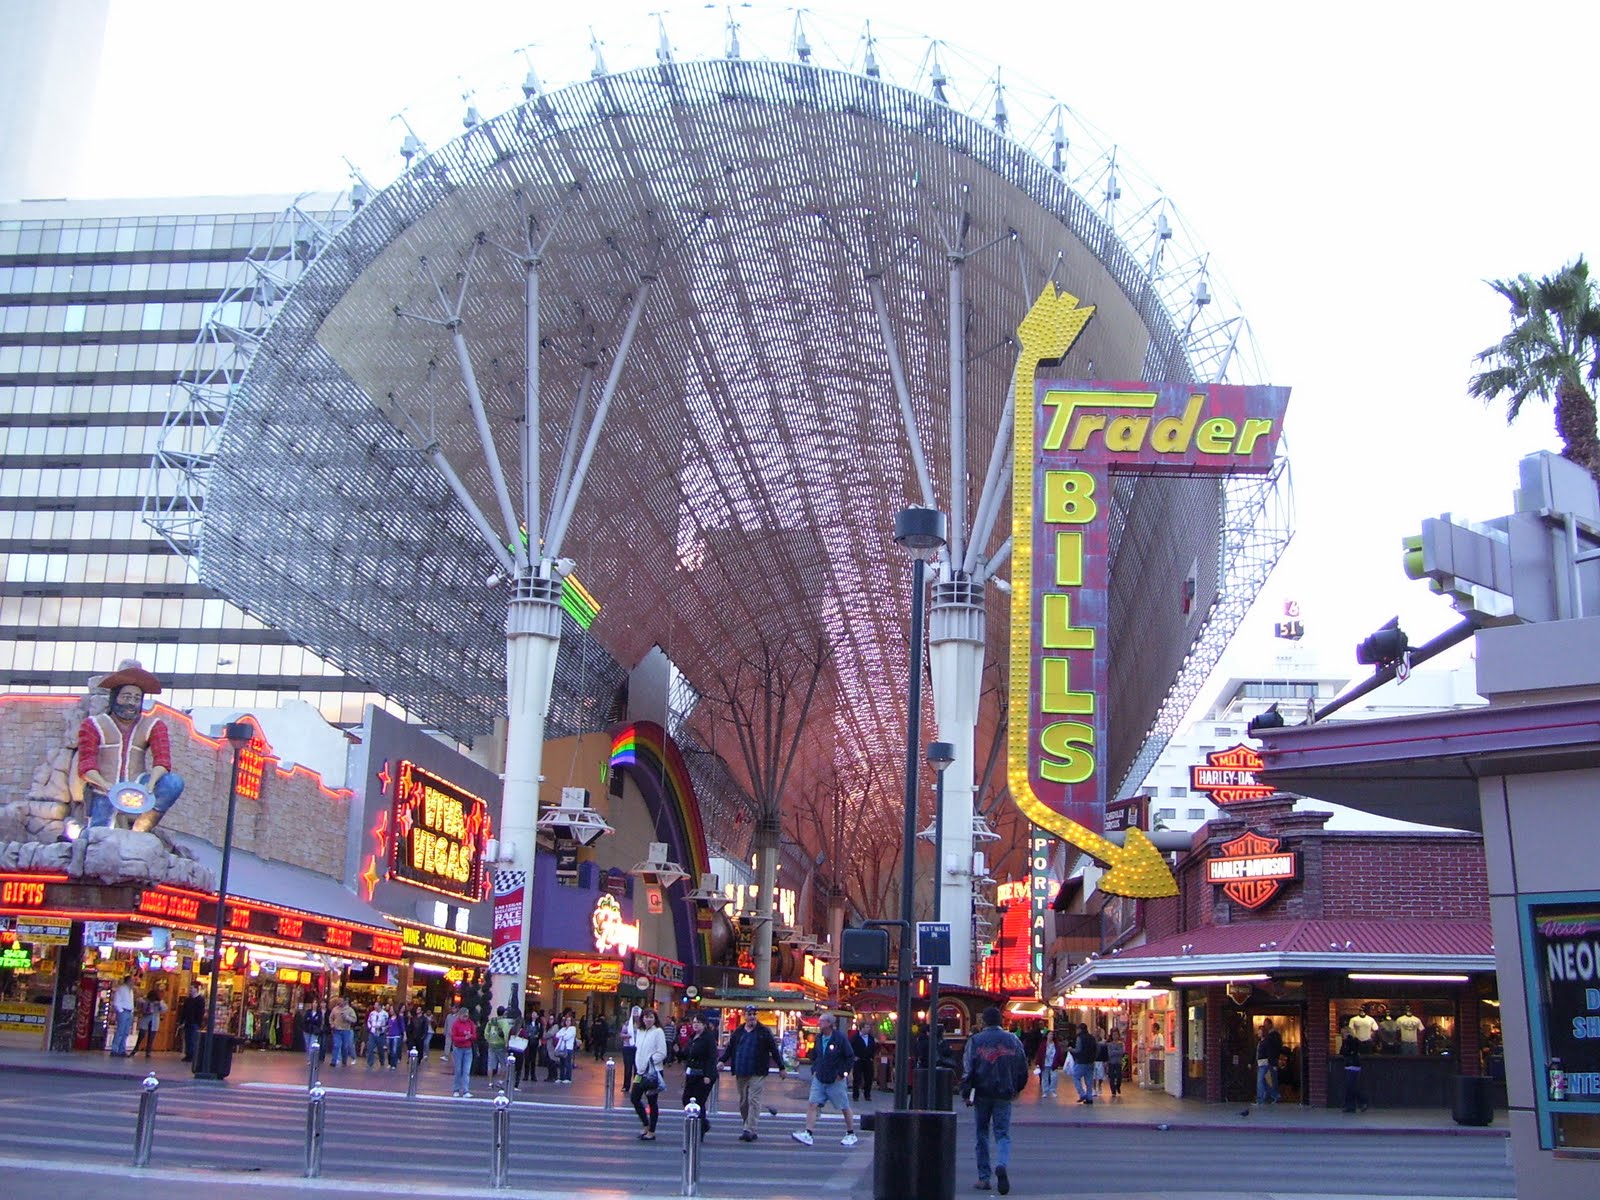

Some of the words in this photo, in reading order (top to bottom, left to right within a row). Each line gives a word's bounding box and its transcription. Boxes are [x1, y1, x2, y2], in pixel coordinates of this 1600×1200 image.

[1042, 390, 1273, 455] Trader
[1040, 470, 1097, 784] BILLS
[425, 786, 464, 840] VIVA
[413, 827, 470, 883] VEGAS
[1228, 836, 1271, 856] MOTOR
[1210, 857, 1291, 878] HARLEY-DAVIDSON
[4, 882, 45, 906] GIFTS
[1230, 880, 1272, 904] CYCLES
[494, 918, 522, 930] FANS
[495, 910, 522, 922] RACE
[403, 927, 420, 946] WINE
[424, 932, 457, 953] SOUVENIRS
[461, 940, 487, 958] CLOTHING
